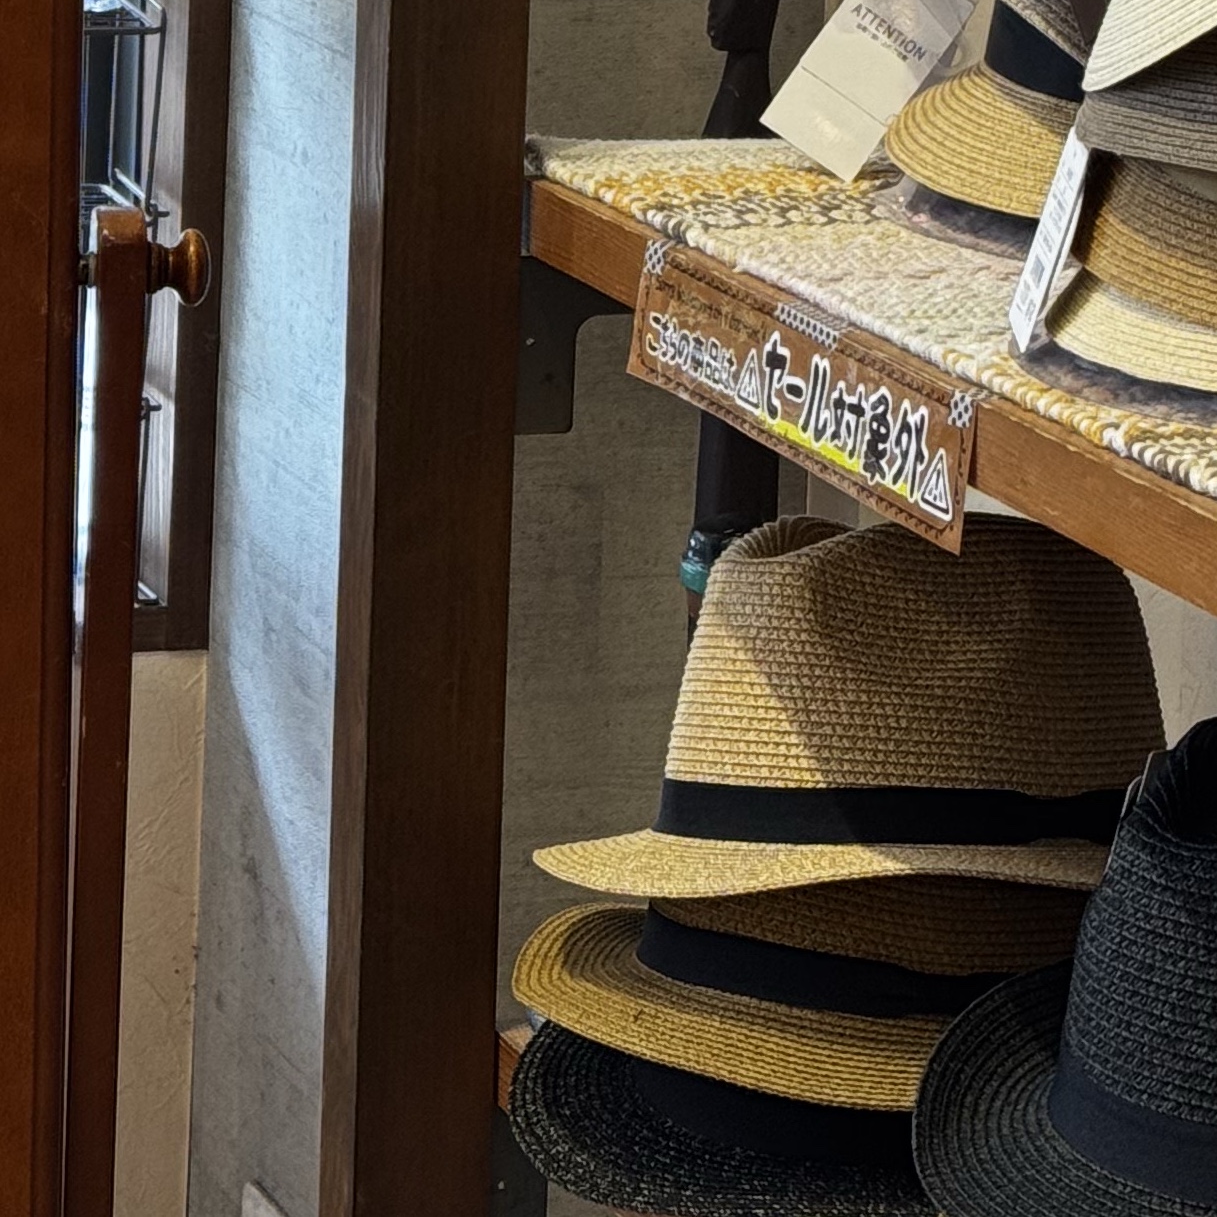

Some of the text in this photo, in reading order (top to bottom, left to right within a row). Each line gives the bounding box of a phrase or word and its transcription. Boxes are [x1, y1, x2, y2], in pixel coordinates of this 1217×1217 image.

[850, 2, 928, 62] ATTENTION
[646, 312, 929, 502] こちらの商品は セール対象外
